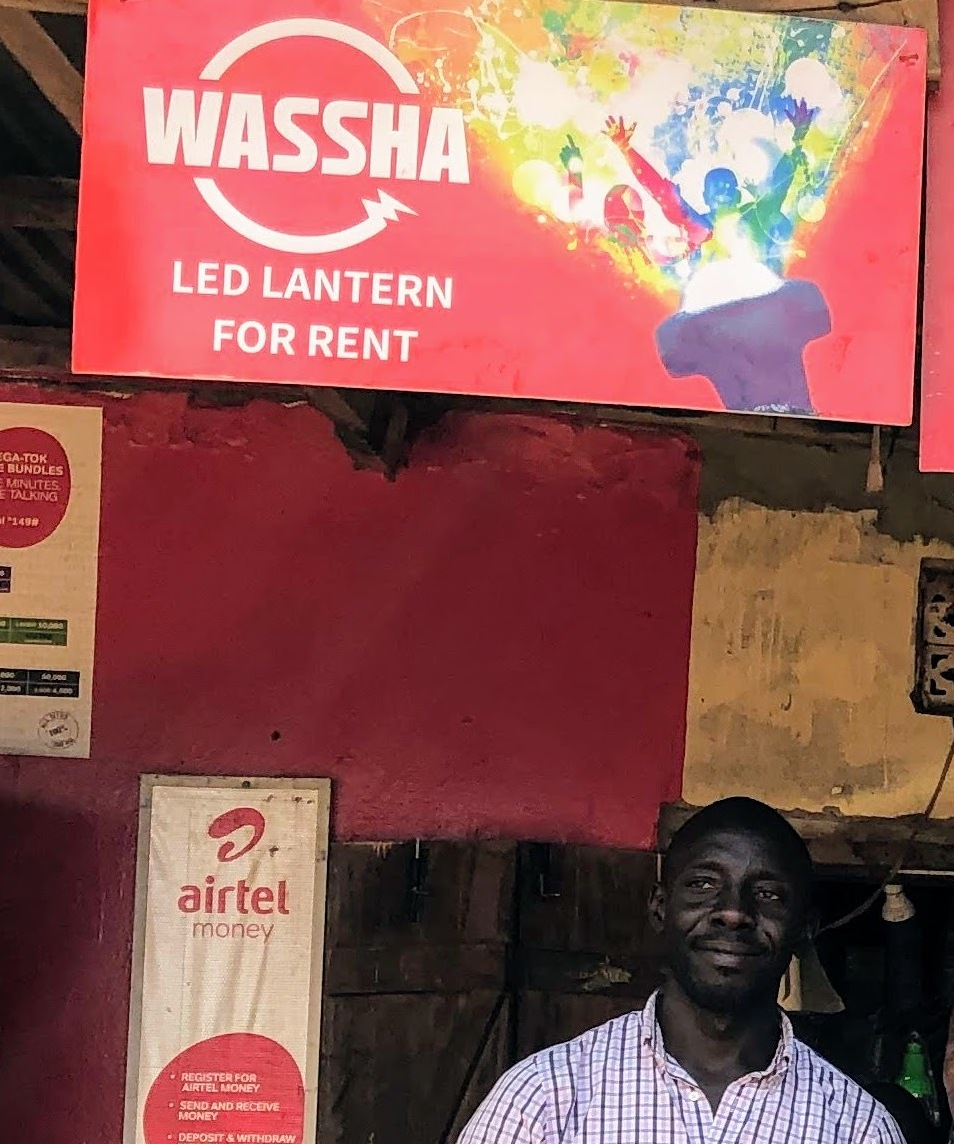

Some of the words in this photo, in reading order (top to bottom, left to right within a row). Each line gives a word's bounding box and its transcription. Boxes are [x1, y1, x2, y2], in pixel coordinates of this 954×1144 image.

[142, 86, 471, 185] WASSHA
[172, 259, 250, 297] LED
[261, 265, 454, 311] LANTERN
[212, 318, 296, 358] FOR
[307, 323, 419, 363] RENT
[7, 463, 64, 476] BUNDLES
[11, 489, 58, 502] TALKING
[177, 874, 290, 915] airtel
[192, 922, 275, 943] money
[181, 1072, 233, 1082] REGISTER
[234, 1073, 257, 1083] FOR
[181, 1083, 219, 1093] AIRTEL
[220, 1083, 261, 1093] MONEY
[179, 1101, 209, 1111] SEND
[211, 1102, 234, 1112] AND
[235, 1102, 281, 1112] RECEIVE
[178, 1111, 219, 1121] MONEY
[178, 1133, 225, 1143] DEPOSIT
[225, 1133, 236, 1143] &
[236, 1134, 297, 1144] WITHDRAW
